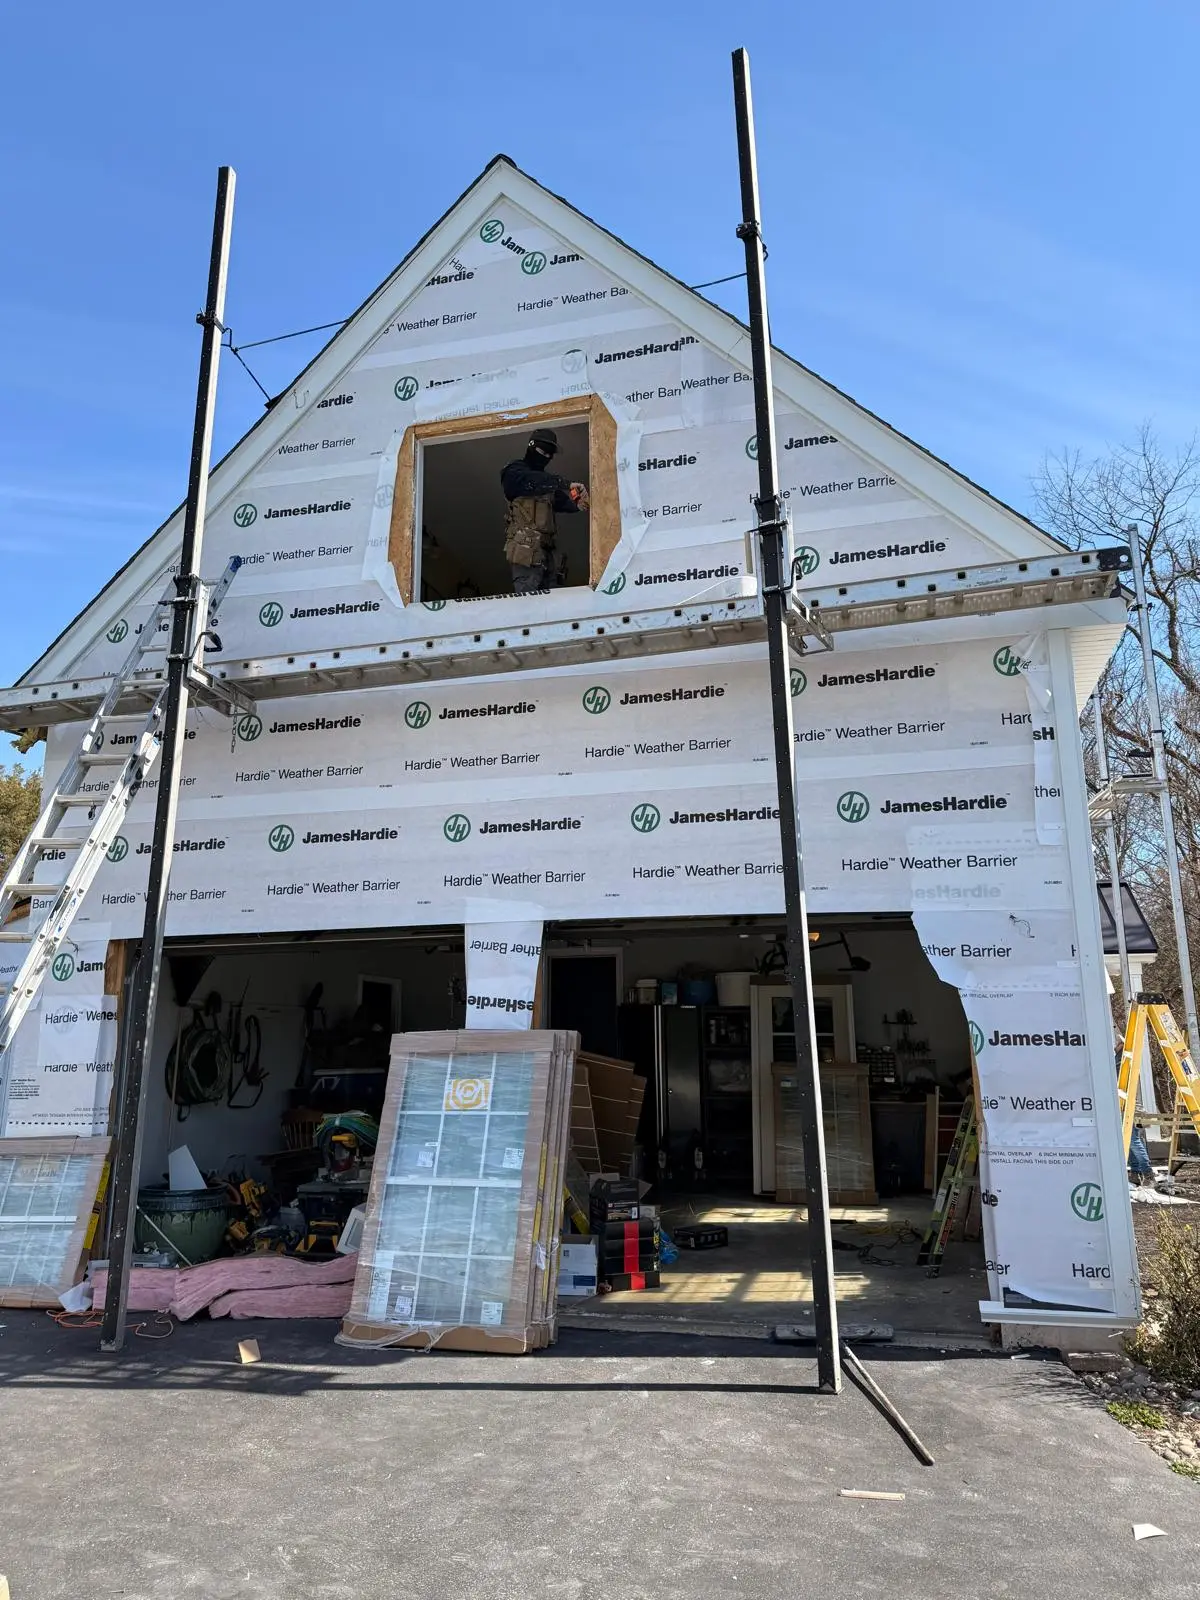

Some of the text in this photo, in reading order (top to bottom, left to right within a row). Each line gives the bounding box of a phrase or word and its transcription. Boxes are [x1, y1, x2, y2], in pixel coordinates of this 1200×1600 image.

[501, 236, 530, 256] Jam
[449, 258, 467, 272] Har
[549, 253, 585, 266] Jam
[562, 289, 607, 305] Weather
[397, 311, 477, 332] Weather Barrier
[681, 375, 730, 390] Weather
[278, 438, 355, 454] Weather Barrier
[800, 482, 853, 496] Weather
[264, 502, 351, 519] JamesHardie
[663, 503, 702, 515] Barrier
[273, 548, 316, 561] Weather
[318, 545, 353, 556] Barrier
[829, 540, 946, 565] JamesHardie
[635, 565, 740, 586] JamesHardie
[290, 601, 380, 619] JamesHardie
[817, 665, 935, 688] JamesHardie
[620, 686, 725, 705] JamesHardie
[439, 703, 536, 720] JamesHardie
[269, 716, 361, 733] JamesHardie
[836, 723, 892, 739] Weather
[897, 721, 945, 735] Barrier
[634, 741, 685, 755] Weather
[689, 738, 731, 751] Barrier
[451, 755, 498, 768] Weather
[501, 753, 540, 765] Barrier
[279, 767, 323, 780] Weather
[327, 765, 363, 777] Barrier
[880, 795, 1007, 814] JamesHardie
[669, 807, 780, 824] JamesHardie
[480, 818, 581, 834] JamesHardie
[302, 828, 399, 844] JamesHardie
[900, 856, 961, 869] Weather
[967, 854, 1018, 868] Barrier
[491, 873, 541, 885] Weather
[545, 870, 586, 883] Barrier
[685, 864, 740, 877] Weather
[190, 889, 226, 901] Barrier
[312, 881, 359, 894] Weather
[362, 880, 400, 892] Barrier
[470, 940, 507, 954] Barrier
[961, 944, 1012, 958] Barrier
[76, 961, 106, 974] Jam
[1011, 1096, 1075, 1111] Weather
[1081, 1097, 1093, 1111] B
